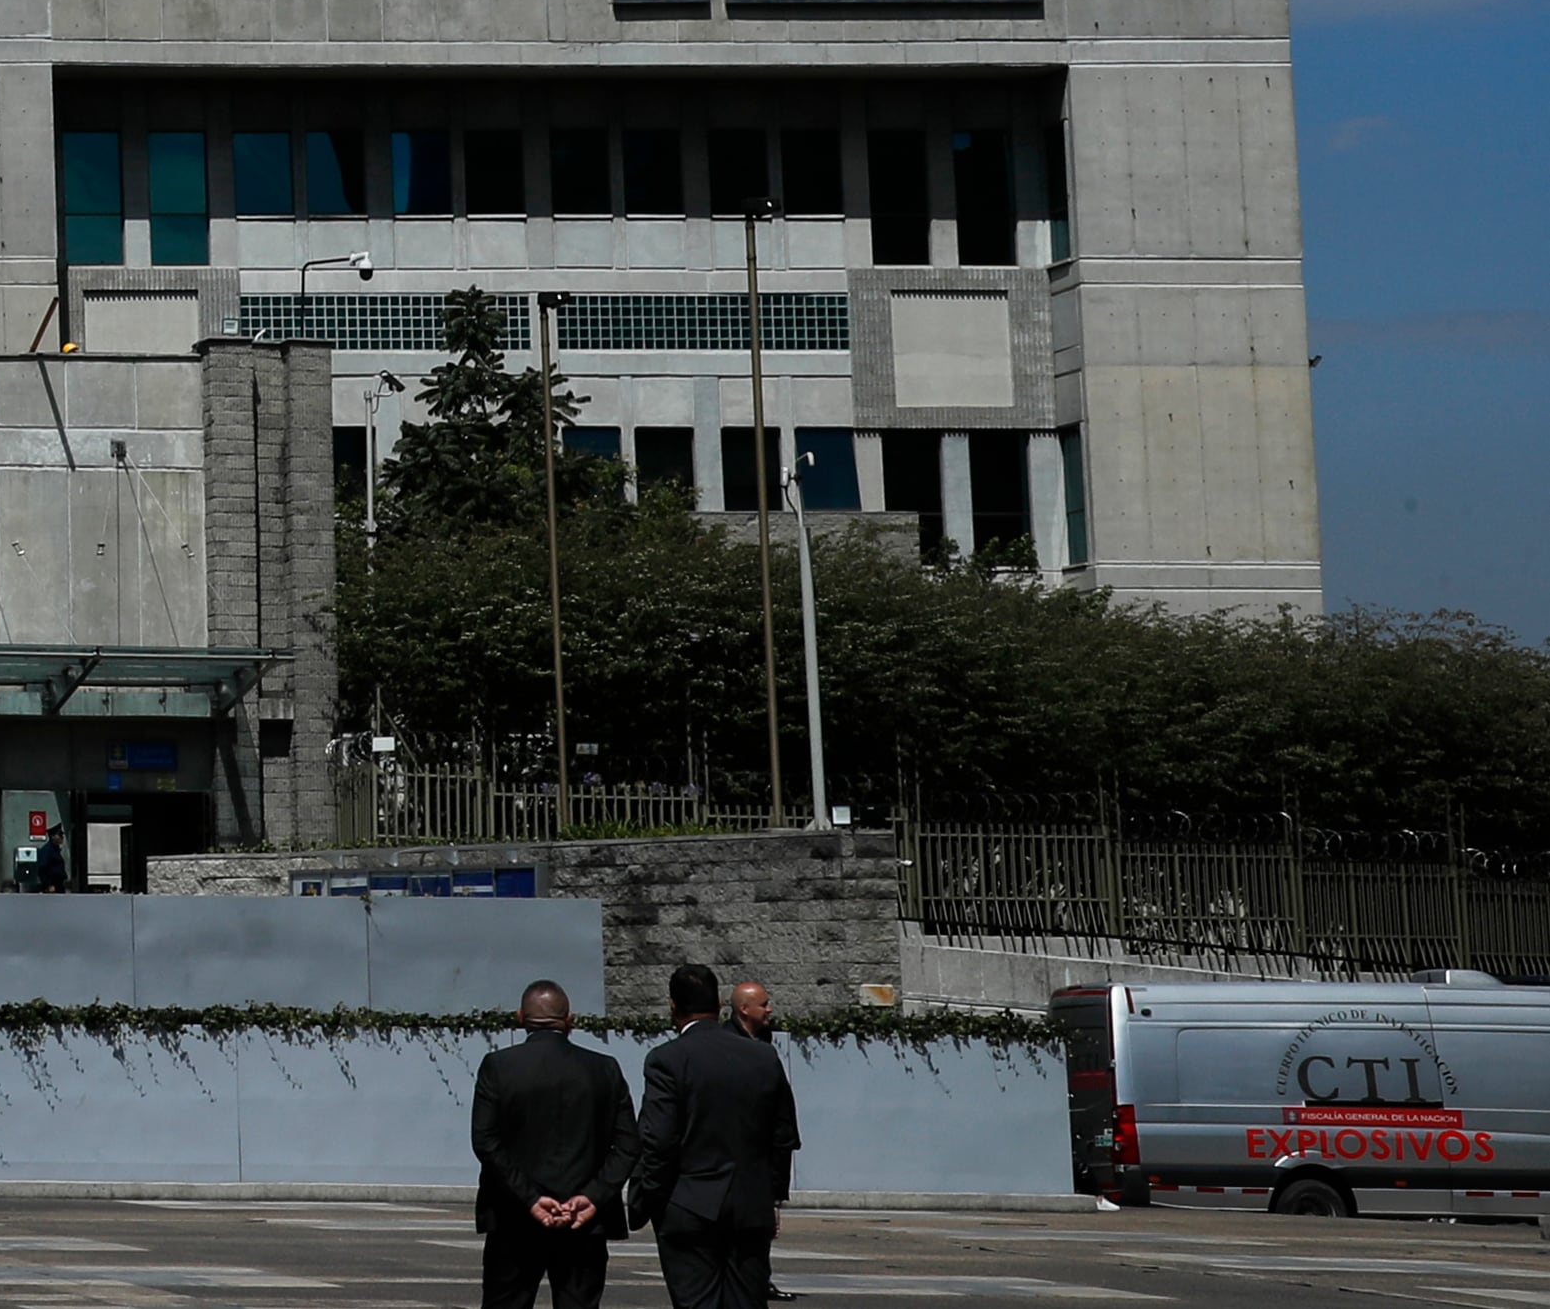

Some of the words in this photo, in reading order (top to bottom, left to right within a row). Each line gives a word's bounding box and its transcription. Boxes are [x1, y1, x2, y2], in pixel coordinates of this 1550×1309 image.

[1276, 1043, 1300, 1096] CUERPO
[1350, 1009, 1367, 1021] DE
[1297, 1055, 1426, 1102] CTI
[1301, 1111, 1343, 1121] FISCALÍA
[1345, 1114, 1390, 1122] GENERAL
[1246, 1128, 1495, 1162] EXPLOSIVOS
